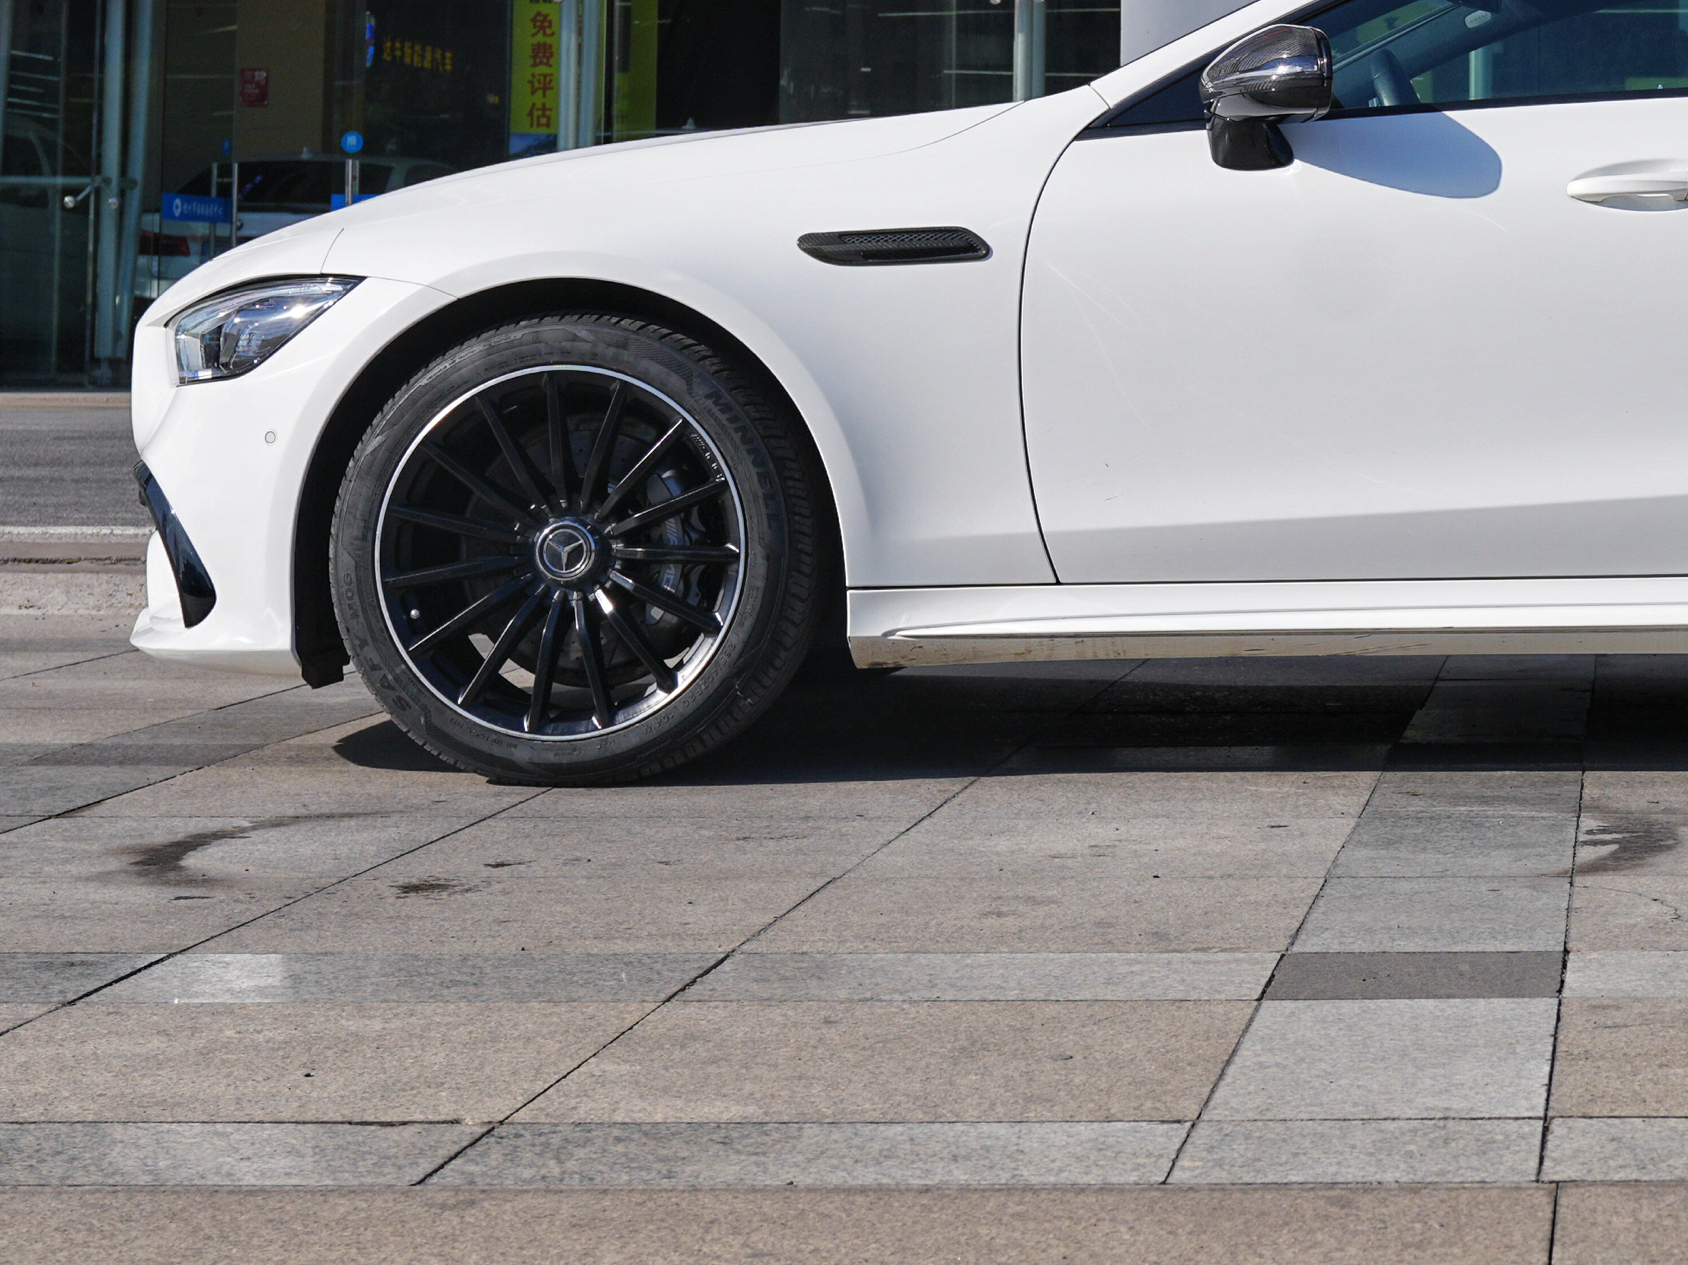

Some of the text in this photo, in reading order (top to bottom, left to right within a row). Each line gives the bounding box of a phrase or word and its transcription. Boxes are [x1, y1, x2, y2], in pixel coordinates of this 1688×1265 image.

[527, 11, 555, 129] 免费评估
[704, 390, 783, 530] MINNELL
[353, 632, 412, 711] SAFY
